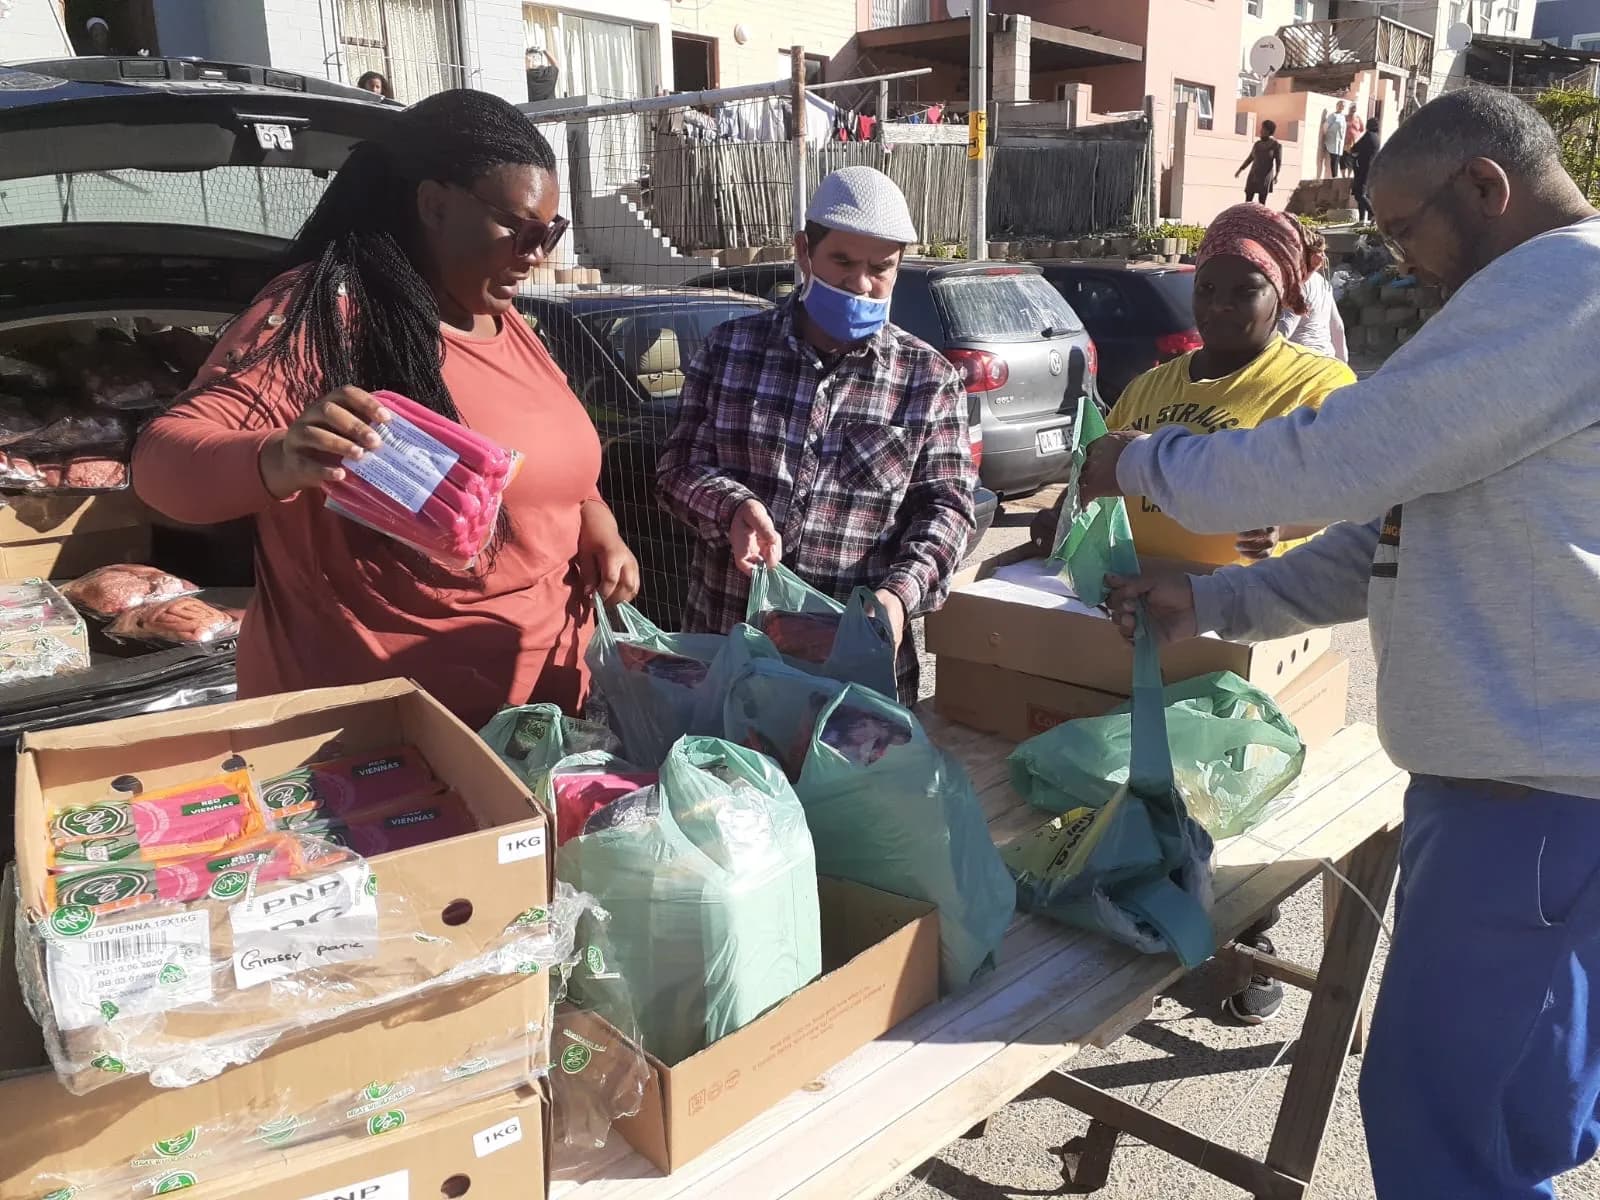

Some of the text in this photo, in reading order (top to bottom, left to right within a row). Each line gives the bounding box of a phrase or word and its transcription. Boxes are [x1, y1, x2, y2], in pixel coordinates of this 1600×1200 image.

[359, 761, 400, 776] VIENNAS
[190, 801, 235, 814] VIENNAS
[201, 798, 221, 806] RED
[391, 813, 435, 825] VIENNAS
[505, 836, 541, 851] 1KG
[263, 880, 341, 915] PNP
[107, 920, 151, 935] VIENNA
[484, 1124, 518, 1144] 1KG
[333, 1184, 381, 1200] NP
